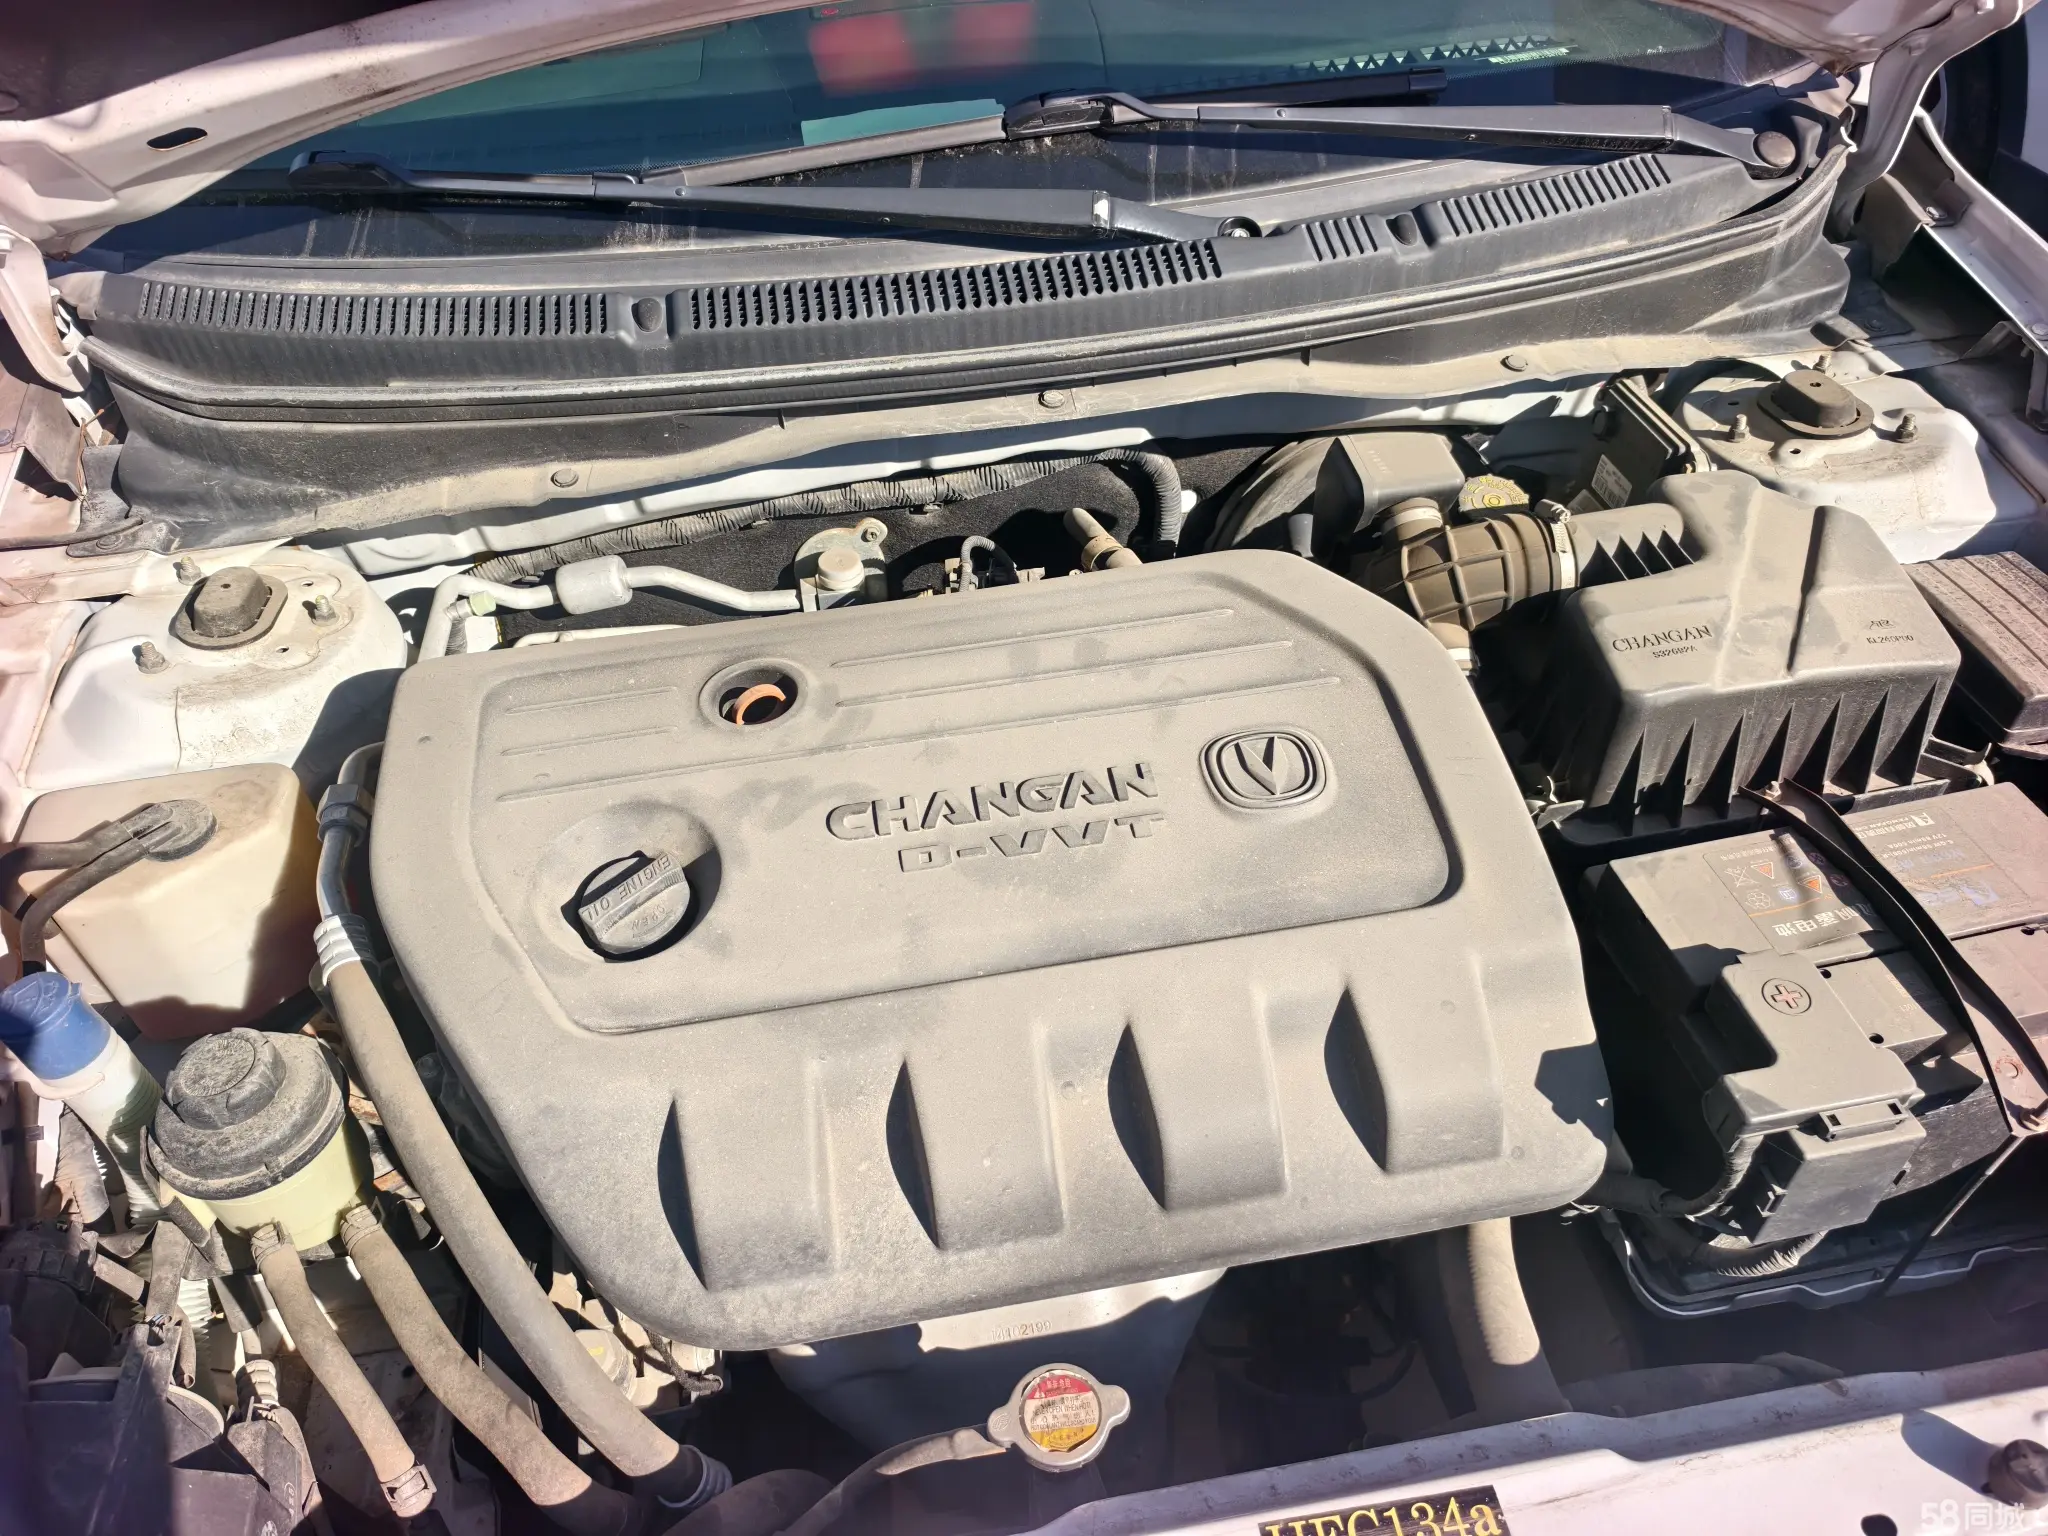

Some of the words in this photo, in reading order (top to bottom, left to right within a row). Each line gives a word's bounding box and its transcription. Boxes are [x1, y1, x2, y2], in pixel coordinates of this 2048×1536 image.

[1612, 625, 1713, 653] CHANGAN
[826, 762, 1159, 841] CHANGAN
[897, 813, 1165, 873] D-VVT
[617, 853, 672, 901] ENGINE
[581, 896, 610, 921] OIL
[1265, 1496, 1502, 1536] FC134a
